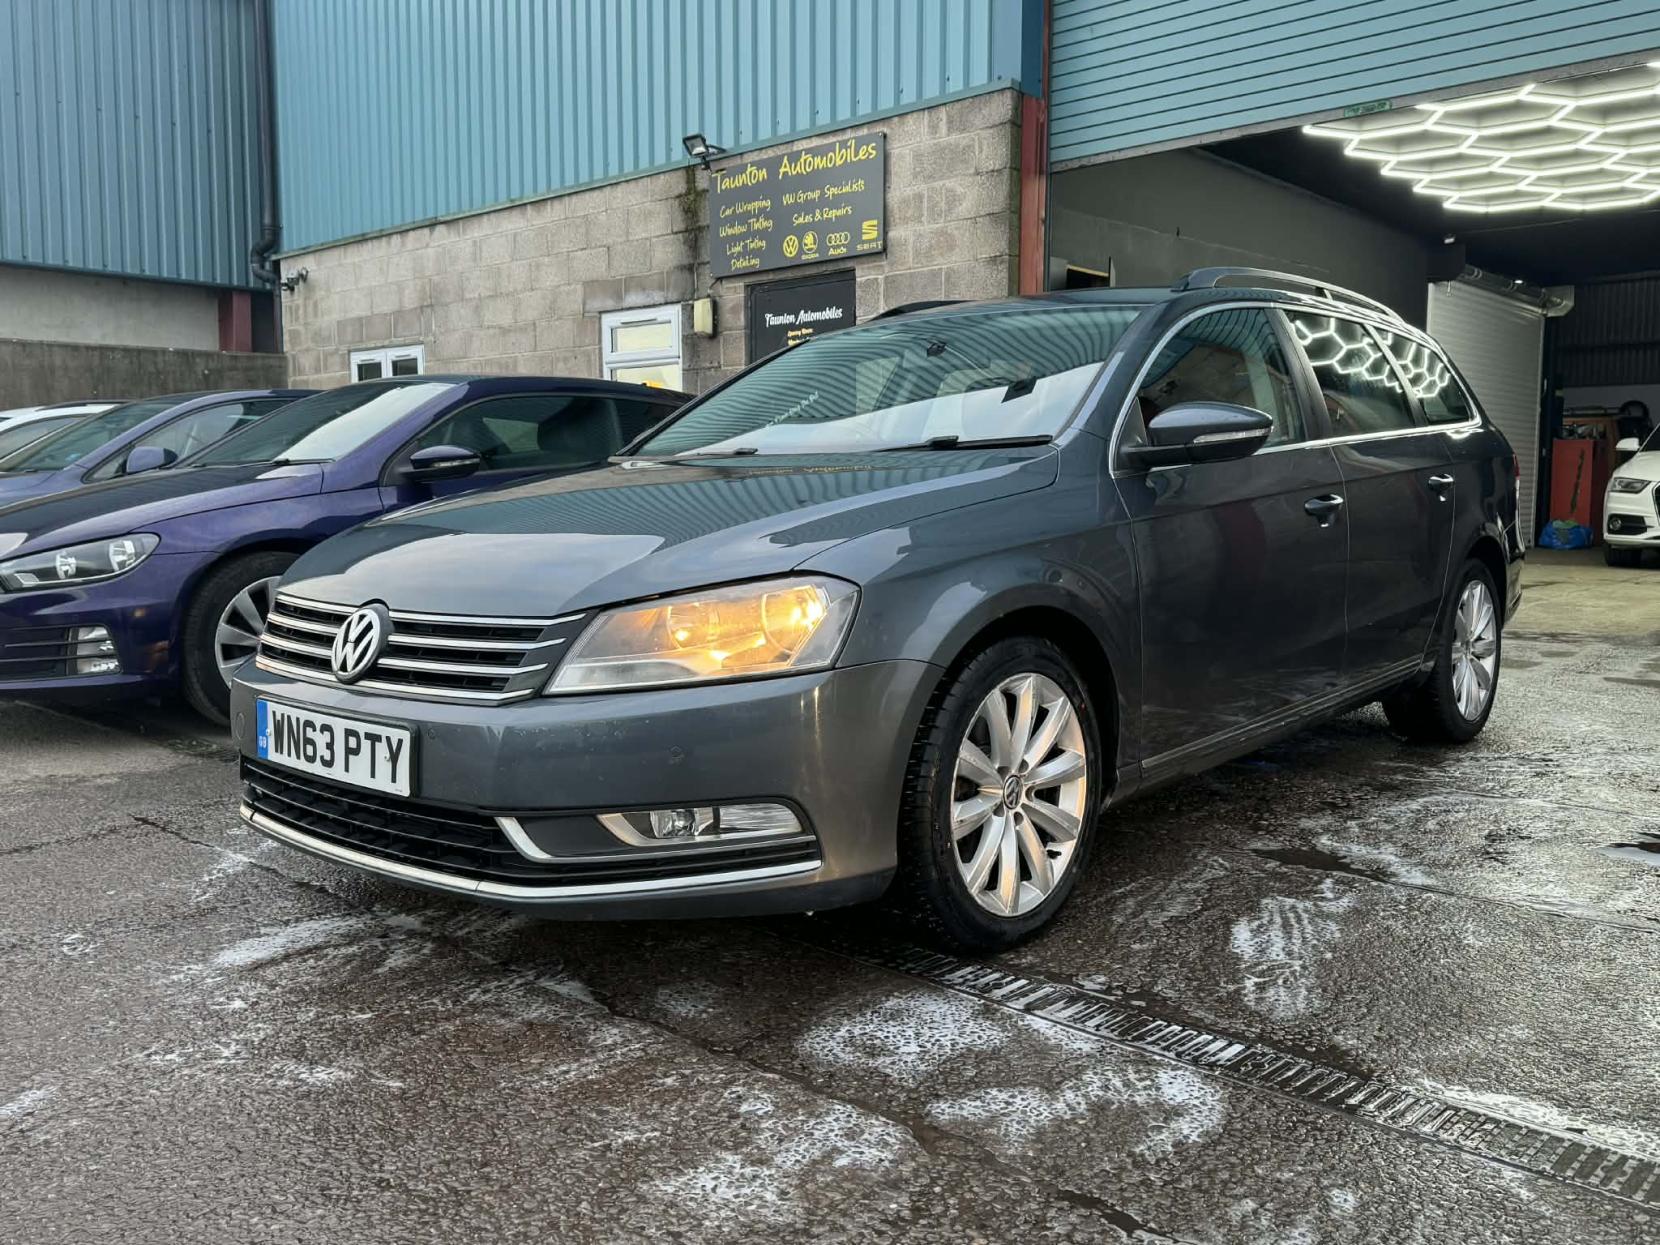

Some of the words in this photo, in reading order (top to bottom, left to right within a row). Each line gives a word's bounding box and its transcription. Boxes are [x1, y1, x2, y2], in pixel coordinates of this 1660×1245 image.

[712, 164, 767, 193] Taunton
[779, 139, 877, 180] Automobiles
[720, 205, 735, 218] Car
[736, 194, 771, 215] Wrapping
[783, 193, 795, 206] VW
[797, 189, 821, 203] Group
[720, 220, 747, 237] Window
[748, 214, 773, 232] Tinting
[792, 212, 813, 226] Sales
[814, 208, 822, 222] &
[822, 202, 852, 222] Repairs
[727, 241, 745, 257] Light
[745, 235, 766, 251] Tinting
[828, 246, 847, 257] Audi
[765, 313, 796, 328] Taunton
[796, 306, 843, 325] Automobiles
[272, 710, 335, 769] WN63
[344, 728, 404, 784] PTY
